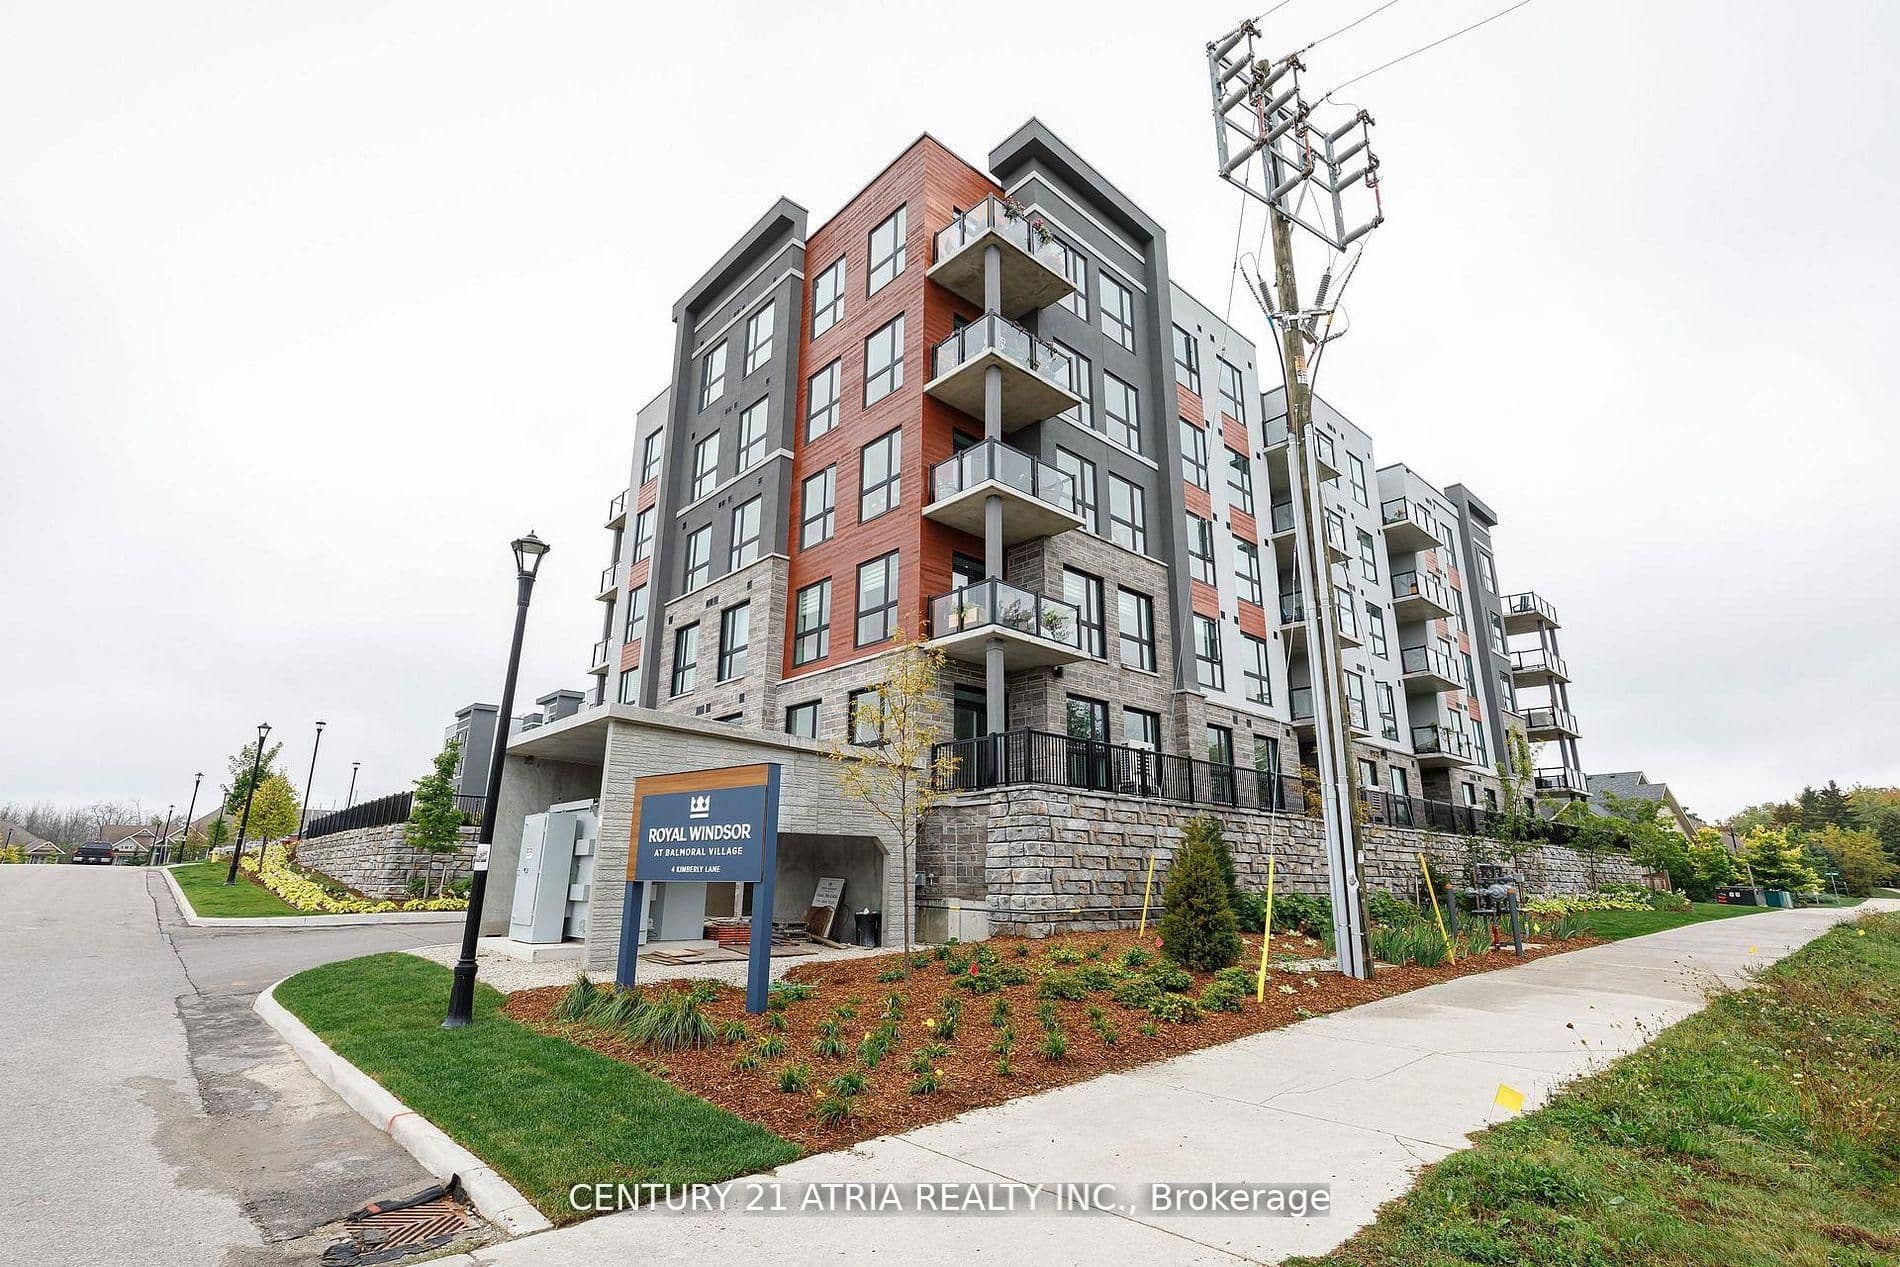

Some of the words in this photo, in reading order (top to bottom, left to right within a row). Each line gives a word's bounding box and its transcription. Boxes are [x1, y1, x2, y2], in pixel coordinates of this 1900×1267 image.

[648, 827, 687, 843] ROYAL
[689, 823, 751, 841] WINDSOR
[653, 848, 663, 857] AT
[665, 847, 706, 857] BALMORAL
[708, 846, 743, 856] VILLAGE
[671, 865, 675, 873] 4
[676, 865, 703, 873] KIMBERLY
[705, 865, 721, 873] LANE
